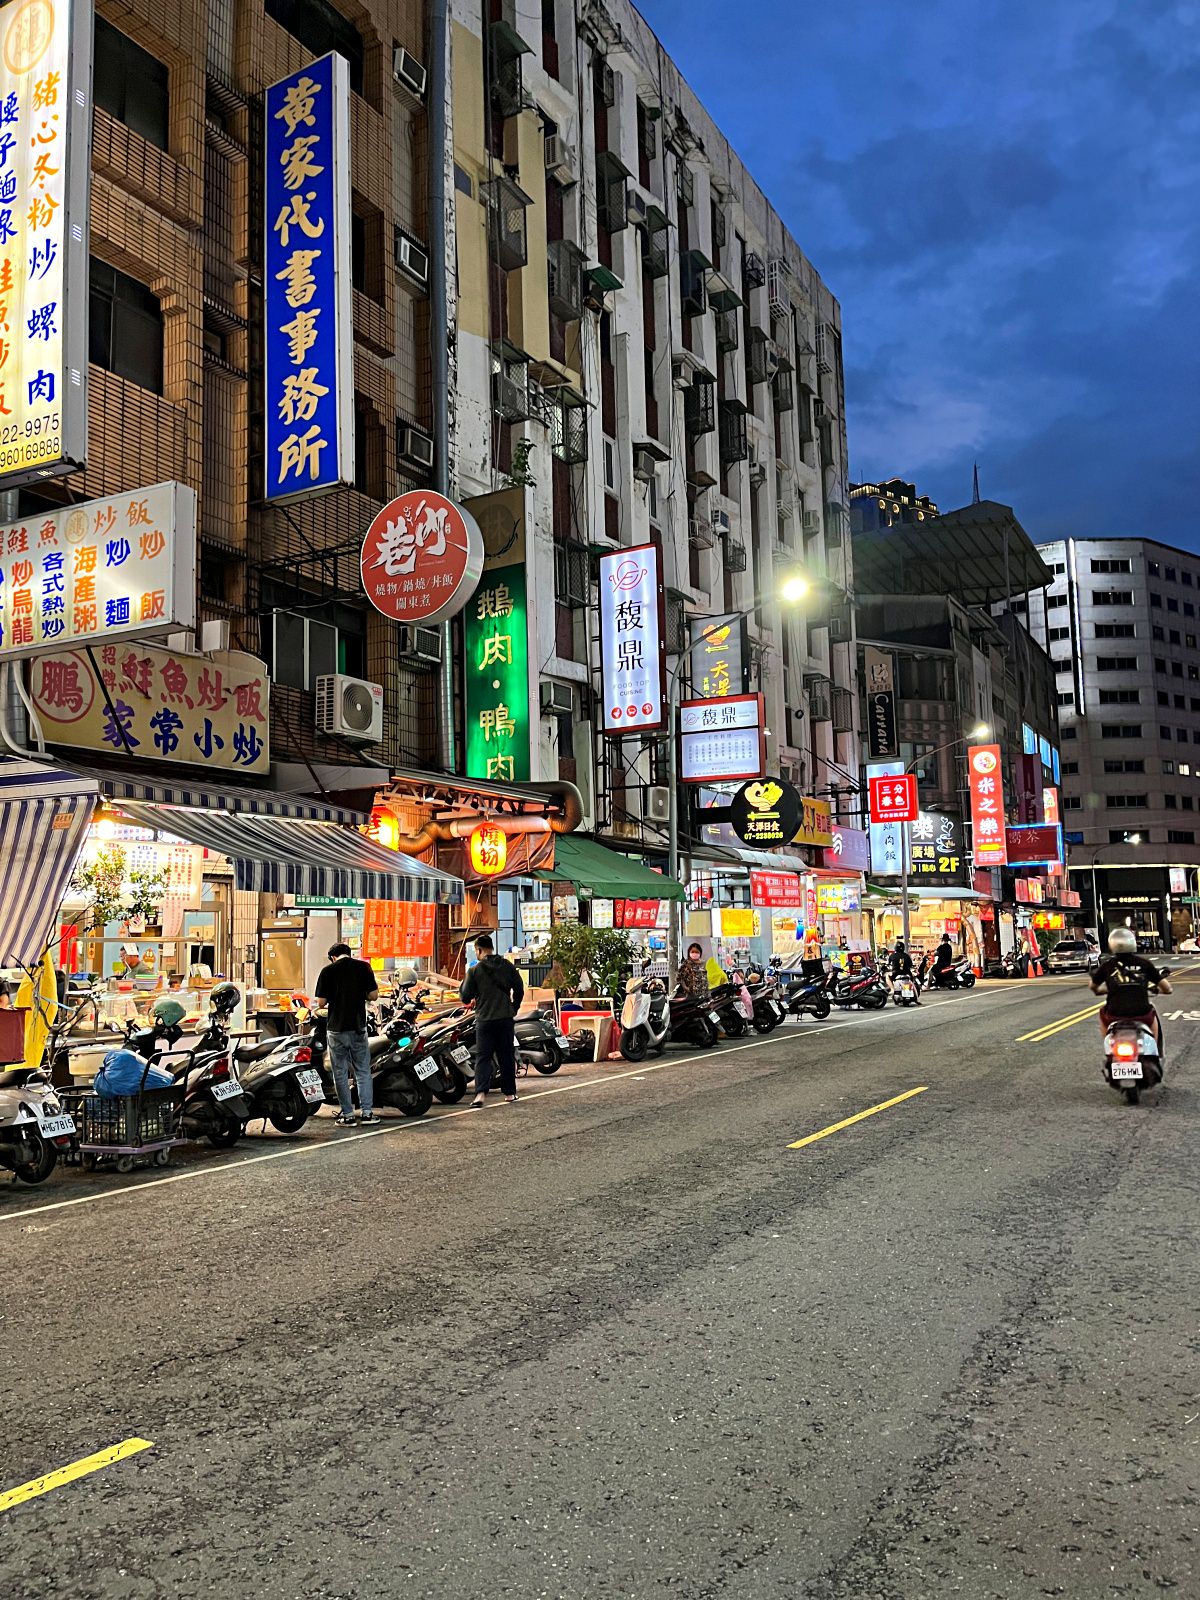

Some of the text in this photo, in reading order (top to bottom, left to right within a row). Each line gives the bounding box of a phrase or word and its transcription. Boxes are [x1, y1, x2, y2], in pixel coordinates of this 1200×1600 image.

[274, 75, 329, 485] 黃家代書事務所
[0, 412, 60, 446] 22-9975
[11, 559, 34, 646] 炒烏龍
[42, 551, 66, 639] 各式熱炒
[73, 545, 98, 635] 海產粥
[105, 537, 131, 628] 炒麵
[139, 529, 166, 622] 炒飯
[615, 599, 644, 673] 馥鼎
[101, 698, 264, 767] 家常小炒
[702, 706, 737, 726] 馥鼎
[479, 827, 499, 867] 燒物
[938, 856, 960, 873] 2F
